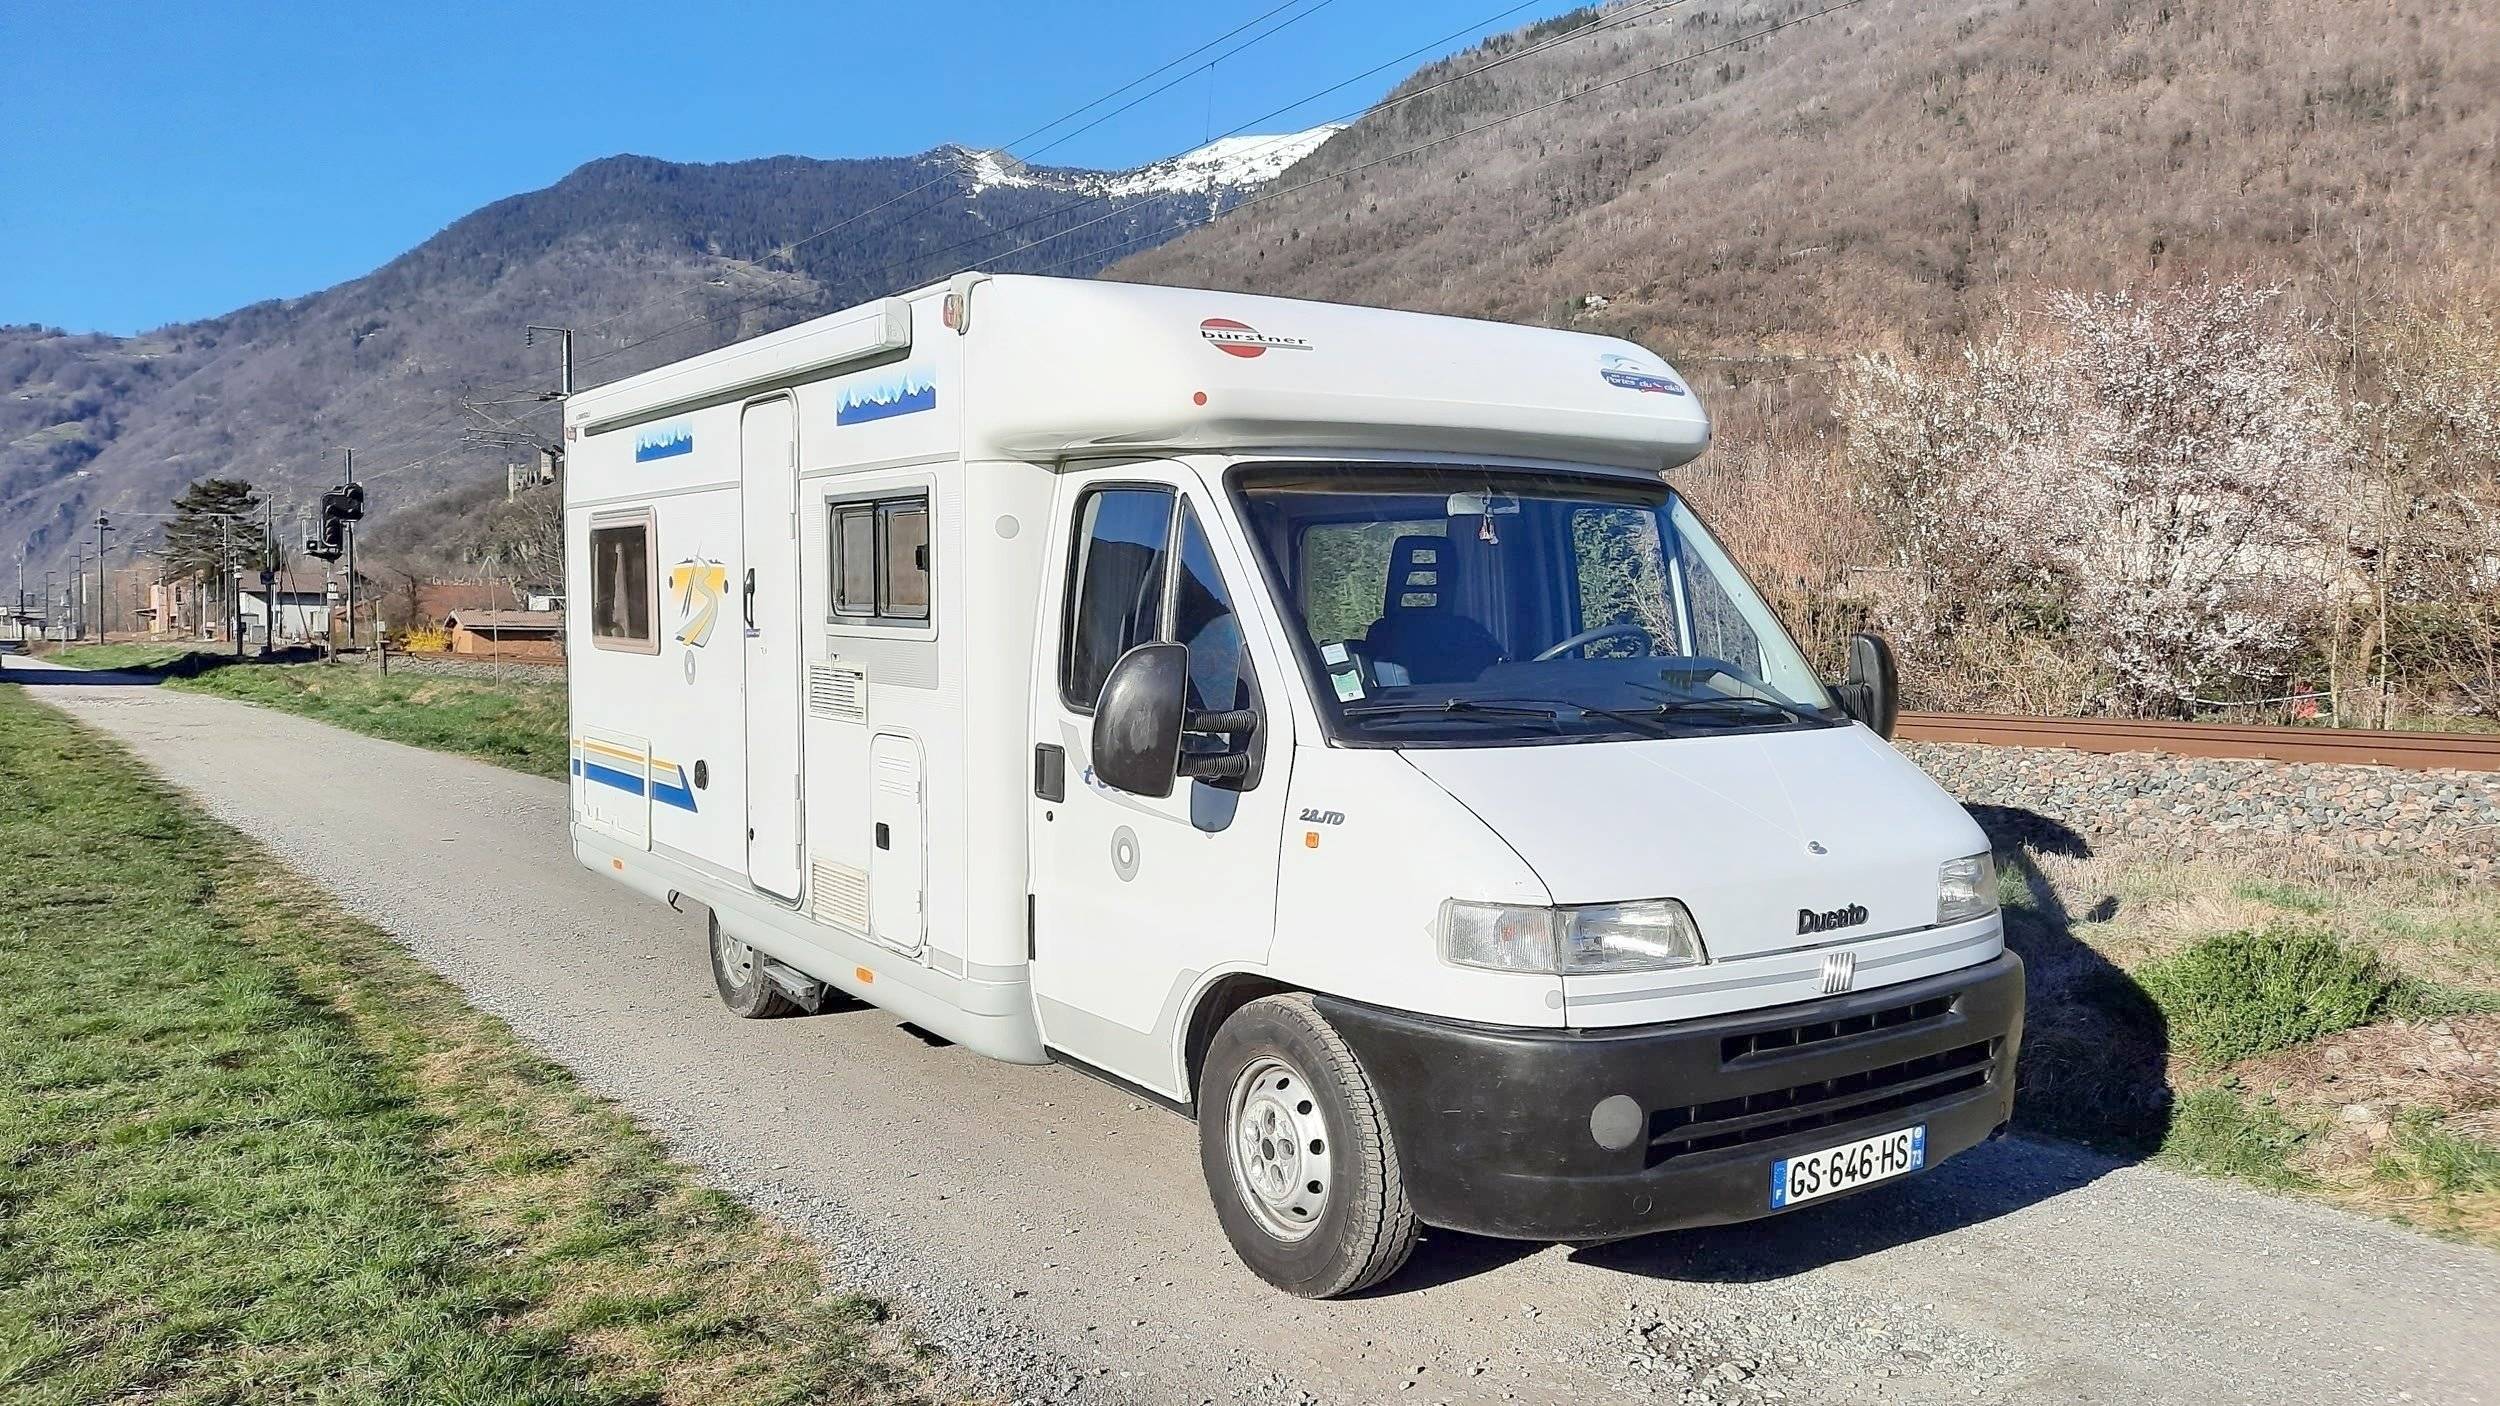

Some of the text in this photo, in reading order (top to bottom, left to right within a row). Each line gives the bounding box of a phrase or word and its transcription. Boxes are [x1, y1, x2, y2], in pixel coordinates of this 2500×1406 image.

[1201, 330, 1308, 345] bürstner
[1796, 902, 1869, 935] Ducato
[1790, 1134, 1908, 1198] GS-646-HS
[1911, 1149, 1922, 1166] 73
[1775, 1188, 1782, 1200] F
